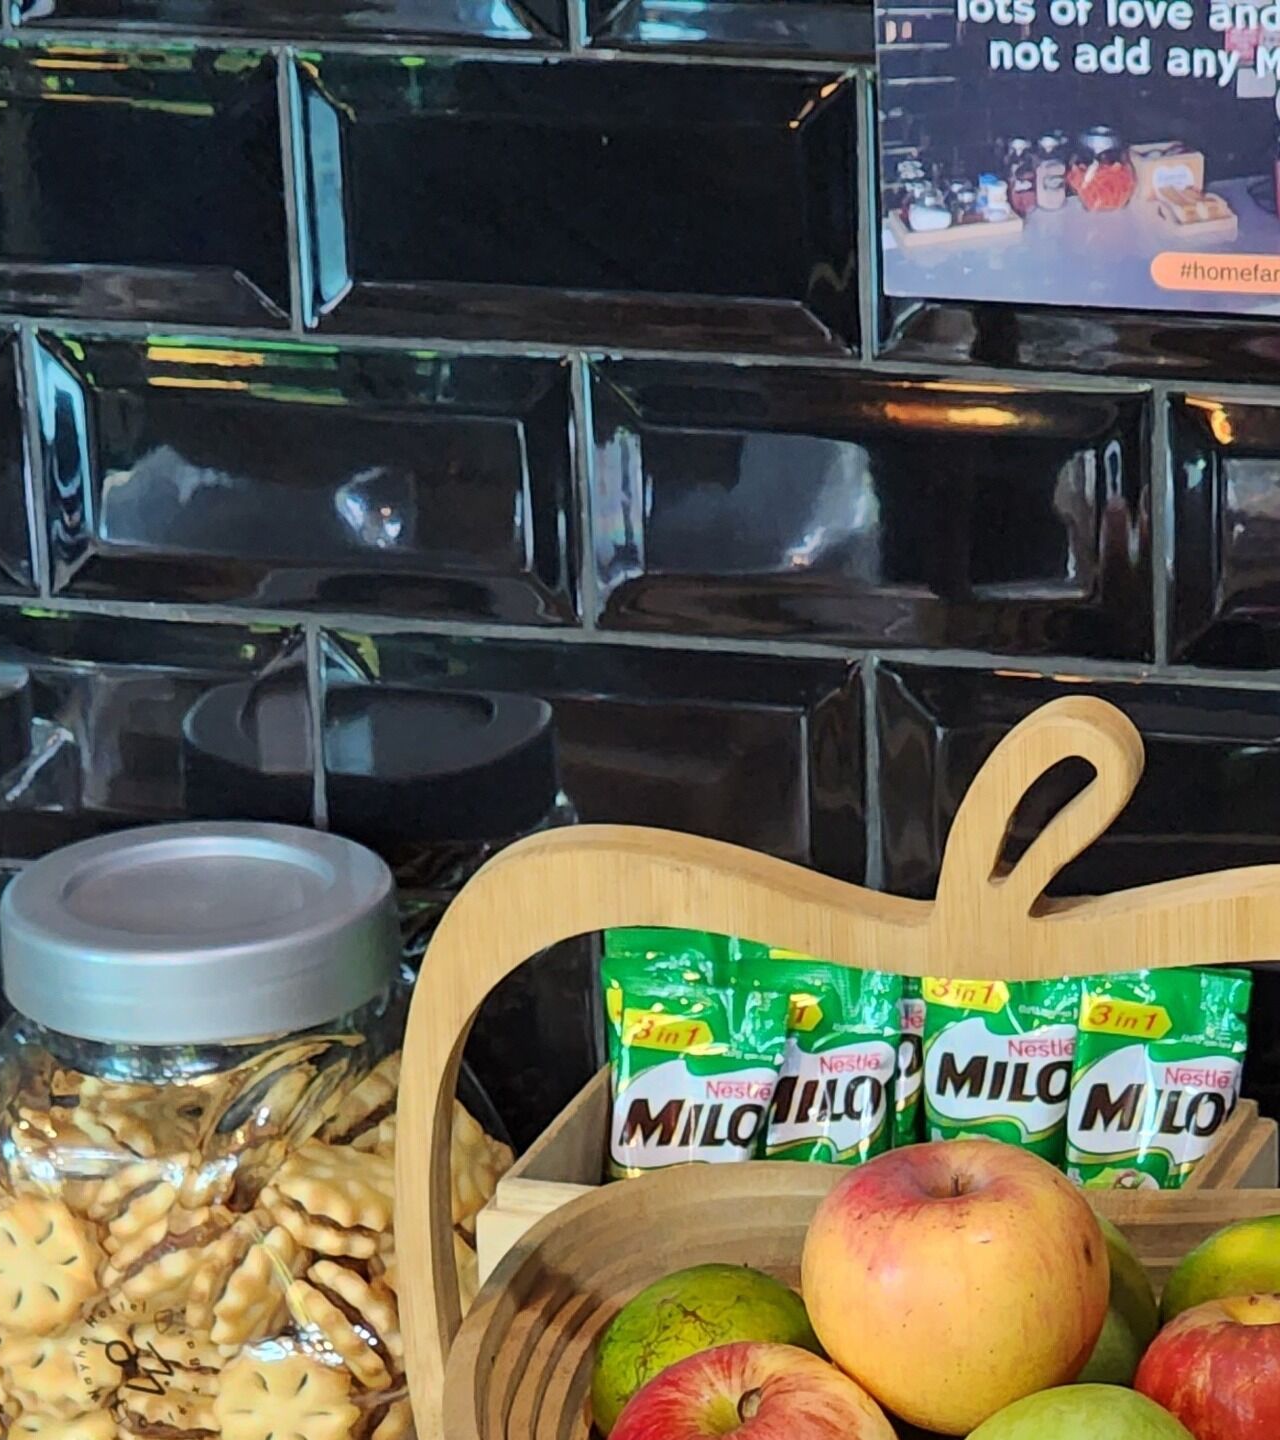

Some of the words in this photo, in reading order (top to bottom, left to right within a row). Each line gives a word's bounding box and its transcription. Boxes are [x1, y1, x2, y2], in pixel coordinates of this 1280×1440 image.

[957, 0, 1036, 24] lots
[1050, 0, 1092, 26] of
[1107, 0, 1193, 30] love
[990, 36, 1060, 72] not
[1074, 36, 1151, 75] add
[1167, 46, 1240, 87] any
[932, 978, 951, 998] 3
[956, 986, 976, 1003] in
[983, 983, 995, 1005] 1
[632, 1018, 655, 1041] 3
[657, 1027, 679, 1044] in
[686, 1026, 701, 1047] 1
[1088, 1003, 1113, 1027] 3
[1115, 1014, 1138, 1031] in
[1144, 1012, 1158, 1032] 1
[936, 1051, 1073, 1105] MILO
[618, 1098, 765, 1149] MILO
